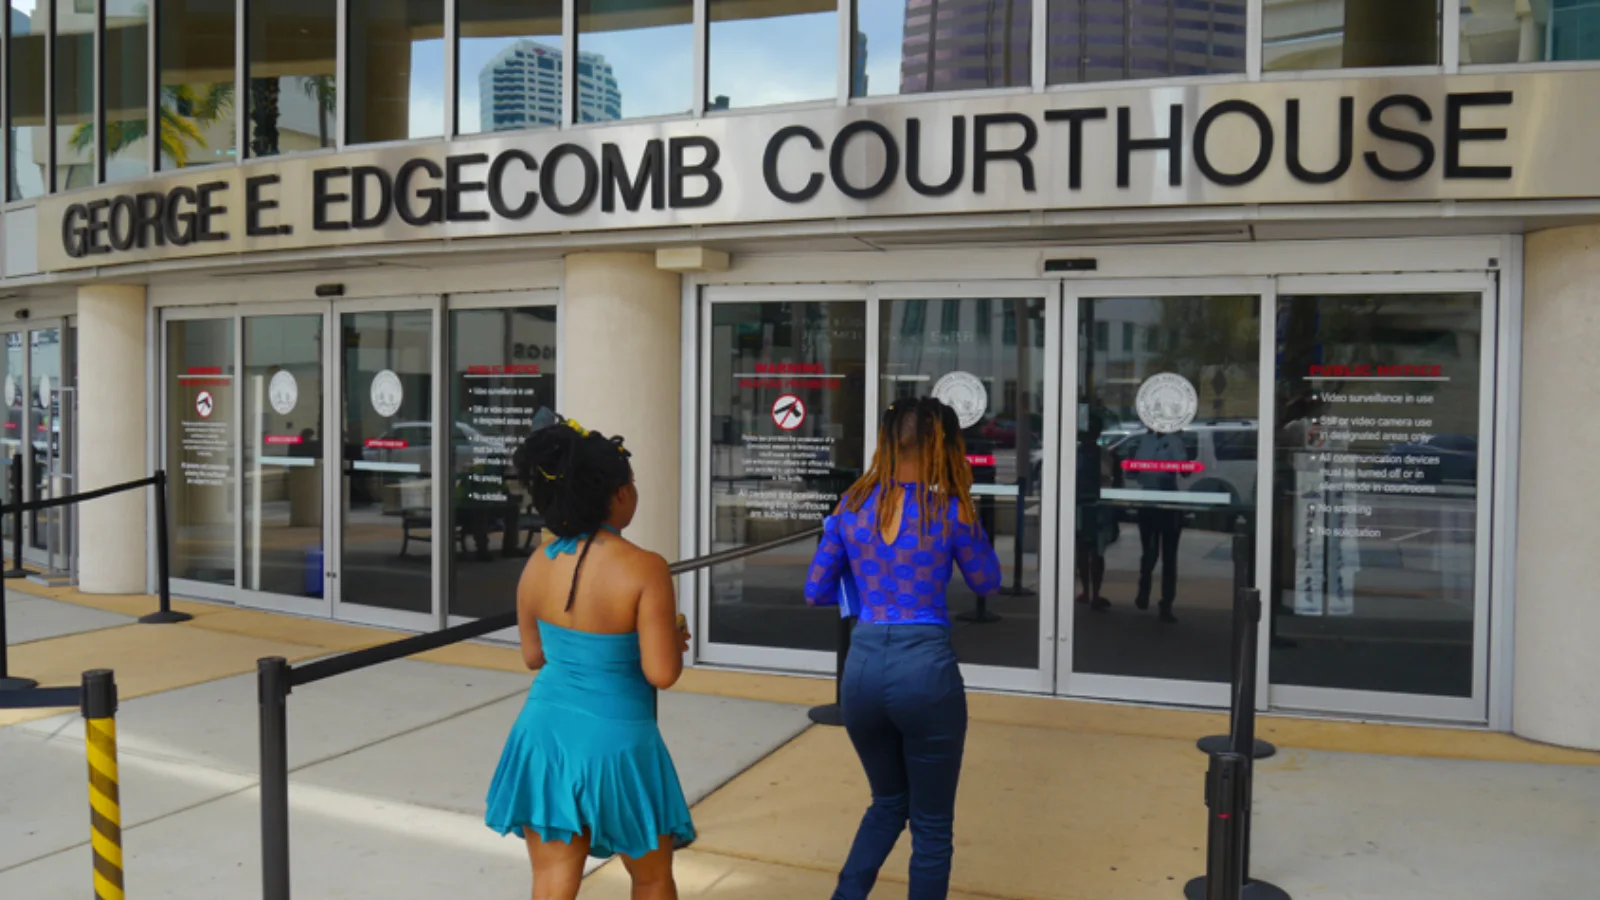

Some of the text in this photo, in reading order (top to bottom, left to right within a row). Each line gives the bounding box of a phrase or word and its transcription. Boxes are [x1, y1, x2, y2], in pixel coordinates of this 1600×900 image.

[62, 90, 1514, 258] GEORGE E. EDGECOMB COURTHOUSE
[755, 363, 824, 374] WARNING
[1309, 364, 1442, 376] PUBLIC NOTICE
[1320, 392, 1434, 404] Video surveillance in use
[1350, 417, 1375, 426] video
[1377, 418, 1412, 427] camera
[1414, 418, 1432, 427] use
[1330, 431, 1380, 443] designated
[1382, 432, 1408, 441] areas
[1333, 454, 1402, 464] communication
[1404, 455, 1440, 465] devices
[1357, 469, 1387, 478] turned
[1387, 469, 1402, 478] off
[1403, 471, 1413, 479] or
[1415, 469, 1424, 478] in
[1344, 482, 1370, 492] mode
[1373, 483, 1382, 492] in
[1383, 484, 1436, 494] courtrooms
[1334, 505, 1372, 516] smoking
[1333, 527, 1381, 537] solicitation
